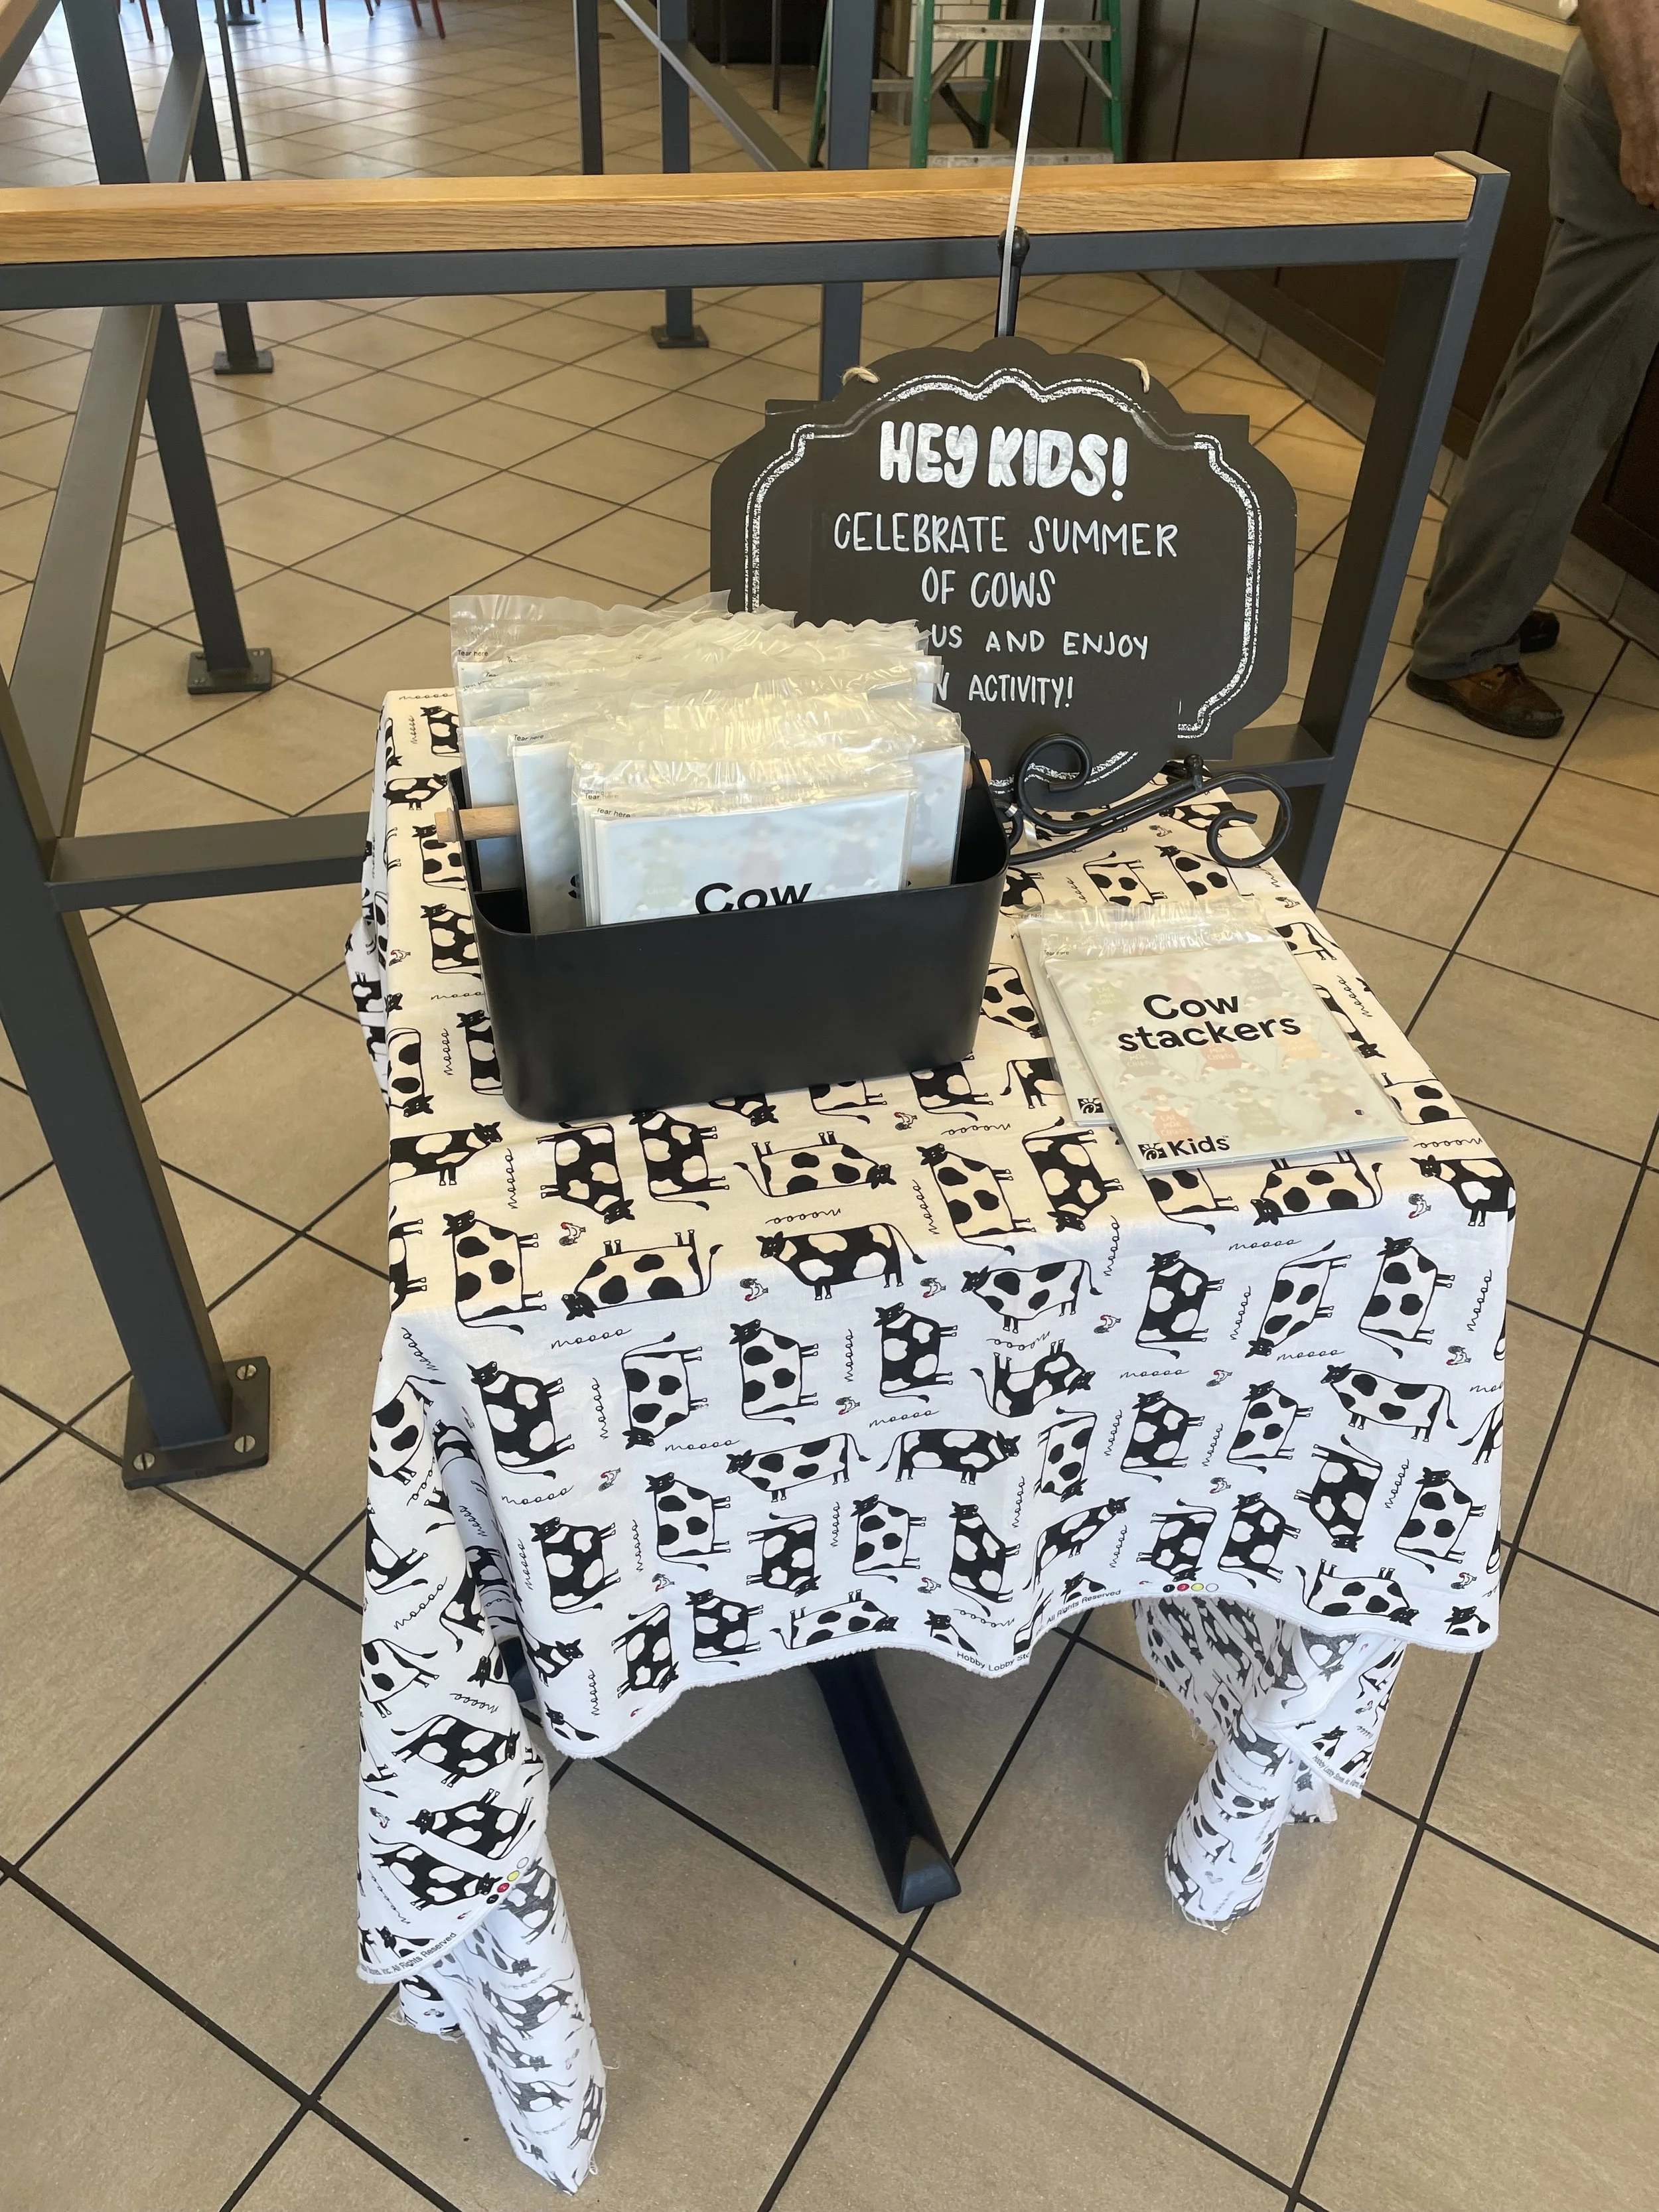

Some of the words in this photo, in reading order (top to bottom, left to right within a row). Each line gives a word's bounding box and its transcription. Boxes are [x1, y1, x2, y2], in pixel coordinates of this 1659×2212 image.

[879, 420, 979, 488] HEY
[987, 425, 1128, 502] KIDS!
[833, 511, 1009, 553] CELEBRATE
[1029, 514, 1179, 559] SUMMER
[921, 565, 956, 605] OF
[970, 569, 1056, 609] COWS
[932, 624, 963, 649] US
[985, 629, 1045, 654] AND
[1063, 631, 1149, 661] ENJOY
[968, 674, 1074, 709] ACTIVITY!
[597, 807, 613, 816] Tear
[695, 882, 813, 915] Cow
[1143, 994, 1239, 1020] Cow
[1118, 1017, 1302, 1053] stackers
[1167, 1135, 1230, 1157] Kids
[1046, 1614, 1055, 1625] All
[1056, 1600, 1080, 1617] Rights
[1082, 1589, 1121, 1604] Reserved
[956, 1650, 985, 1668] Hobby
[988, 1659, 1015, 1672] Lobby
[420, 1932, 457, 1958] Reserved
